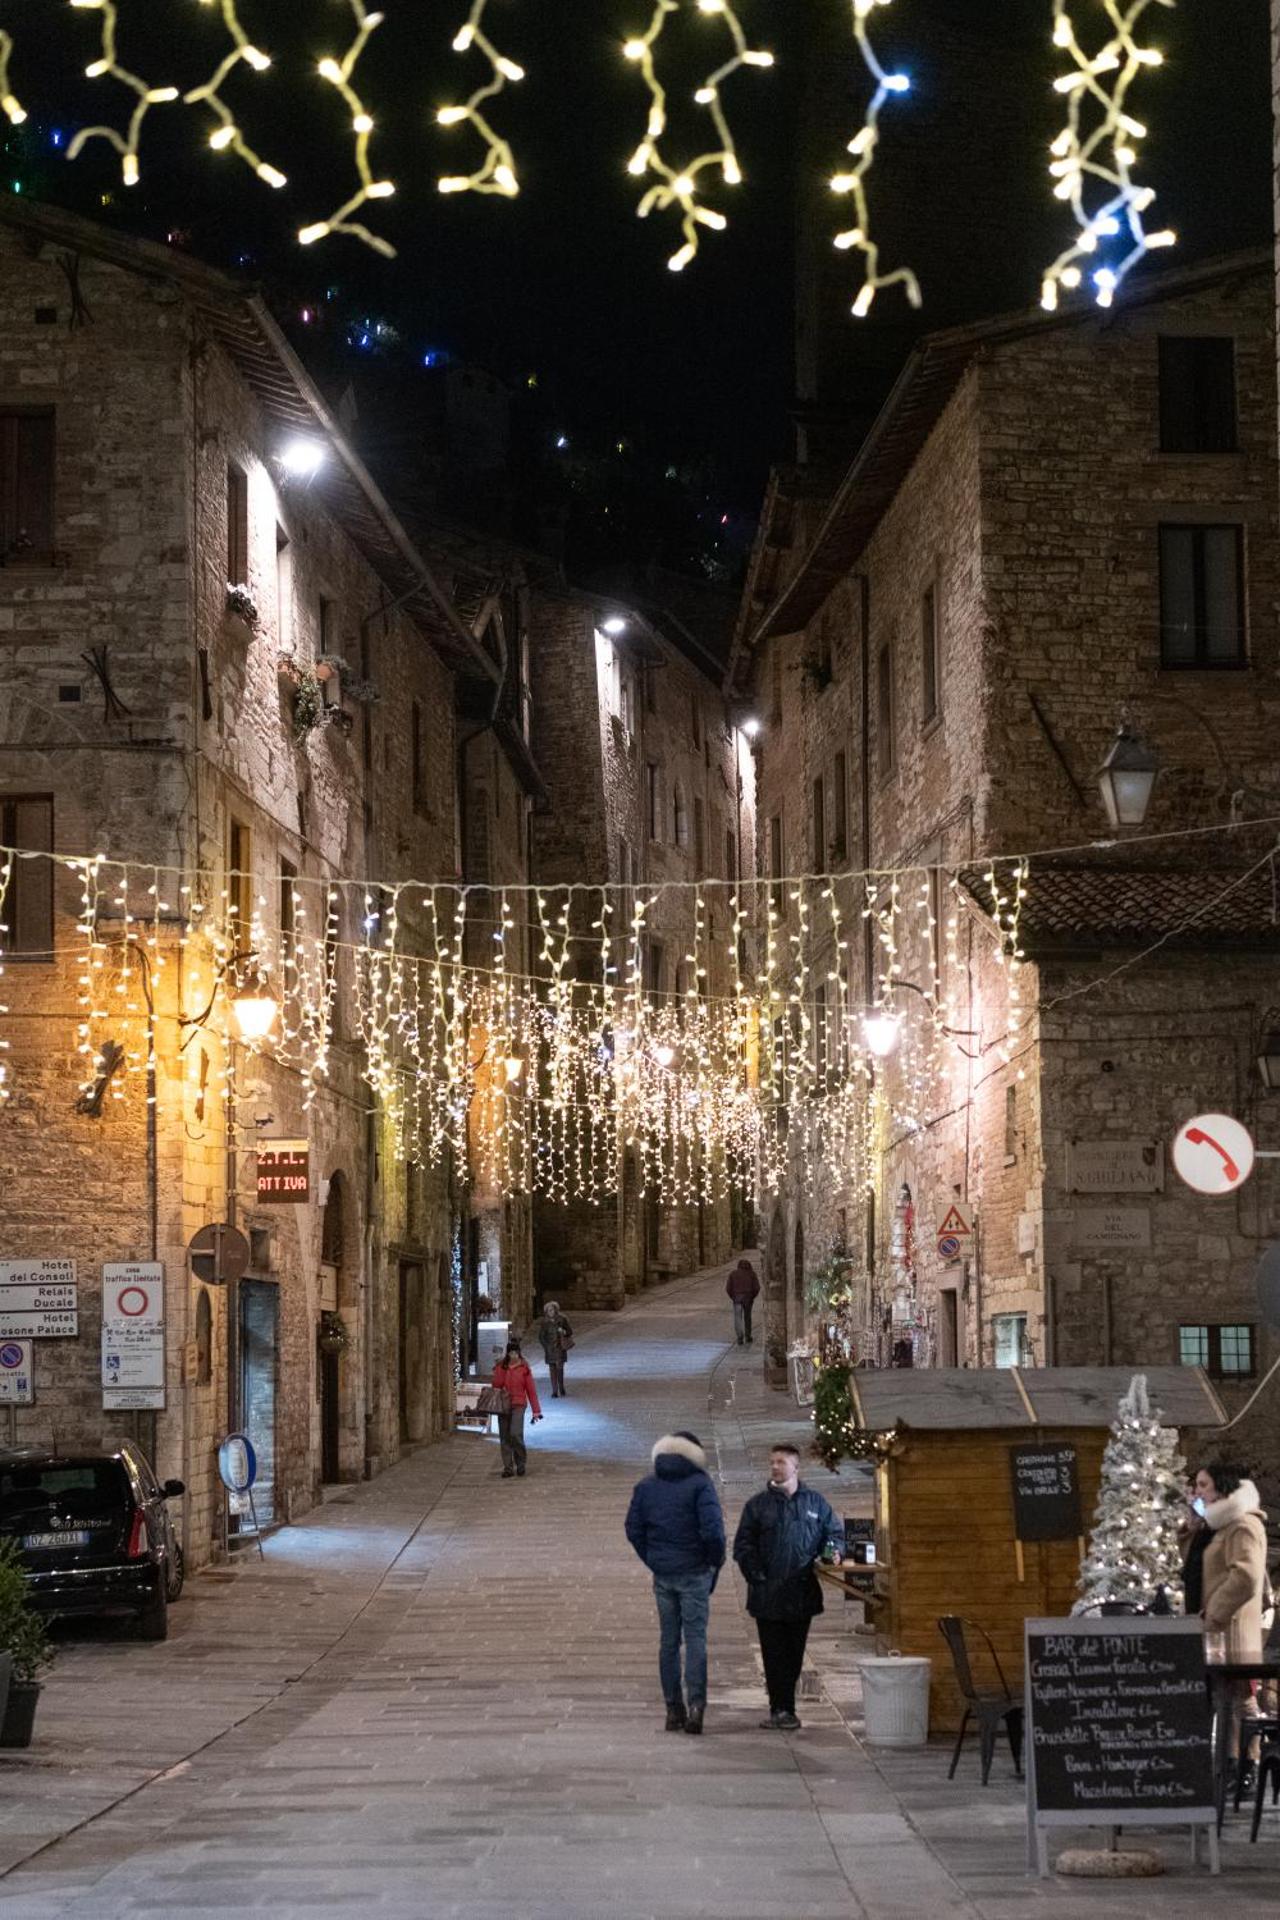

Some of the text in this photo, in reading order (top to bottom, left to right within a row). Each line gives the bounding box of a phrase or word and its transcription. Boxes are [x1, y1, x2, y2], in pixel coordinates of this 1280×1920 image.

[257, 1176, 307, 1191] ATTIVA
[42, 1261, 73, 1269] Hotel
[30, 1271, 74, 1281] Consoli
[39, 1287, 73, 1296] Relais
[34, 1298, 74, 1308] Ducale
[43, 1313, 74, 1322] Hotel
[37, 1325, 75, 1334] Palace
[1044, 1636, 1076, 1657] BAR
